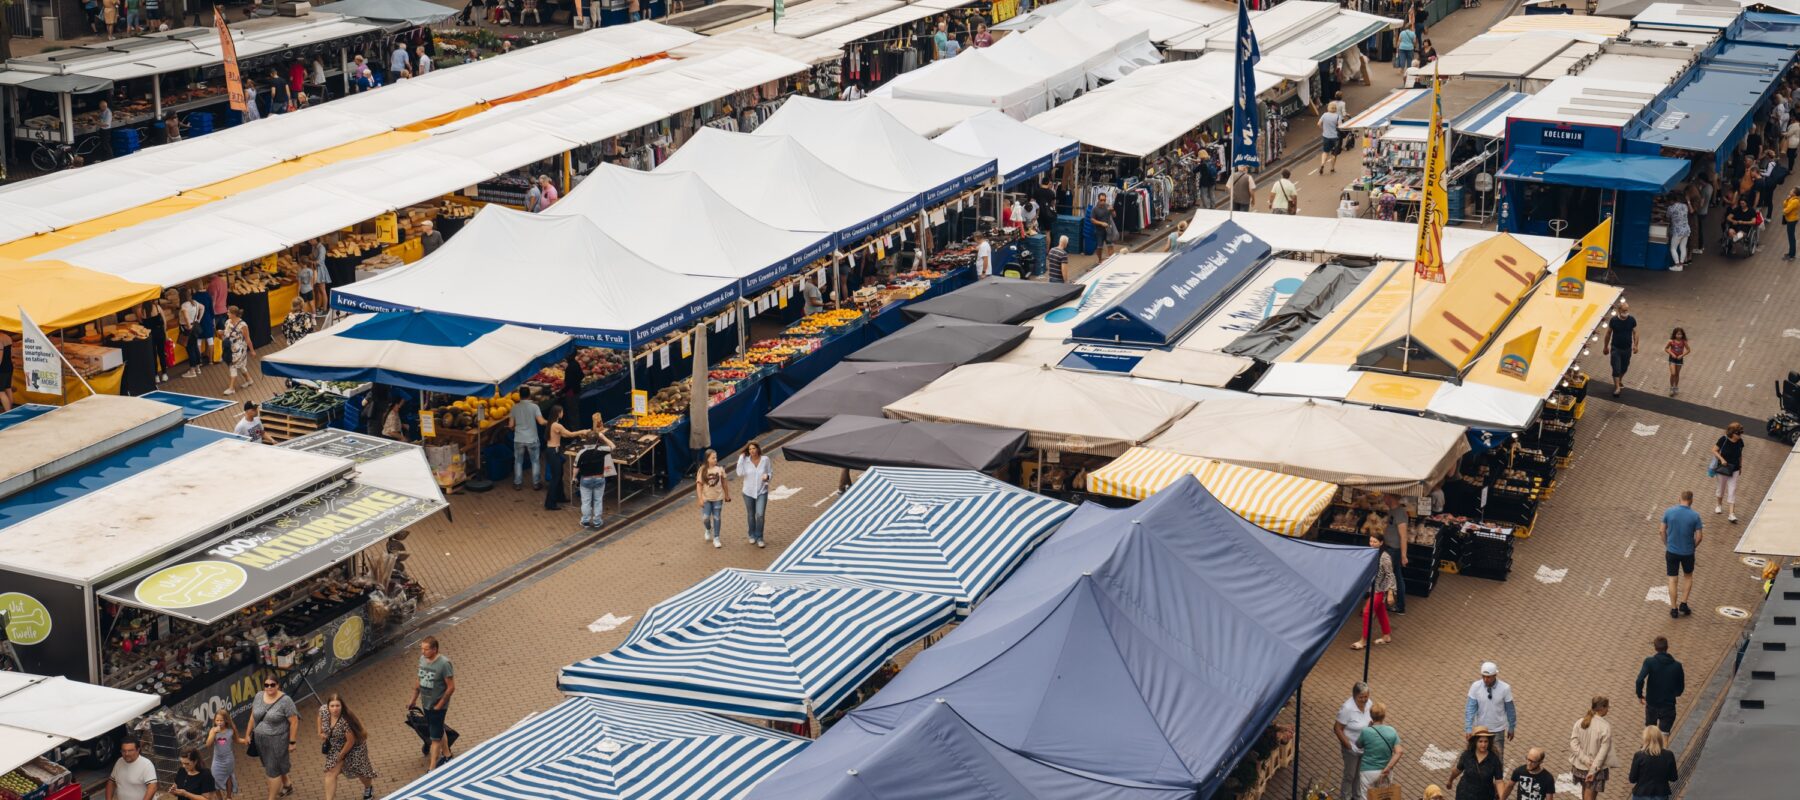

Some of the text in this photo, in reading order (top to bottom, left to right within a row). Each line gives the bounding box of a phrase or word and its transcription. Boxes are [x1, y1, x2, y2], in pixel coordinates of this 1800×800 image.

[1543, 130, 1582, 140] KOELEWIJN
[337, 294, 357, 307] kros
[358, 301, 390, 313] Groenten
[636, 330, 650, 340] kros
[650, 320, 670, 335] Groenten
[673, 313, 685, 324] Fruit
[596, 333, 604, 342] &
[604, 334, 625, 343] Fruit
[40, 370, 58, 380] BEST
[230, 489, 409, 569] NATUURLIJKE
[208, 534, 272, 558] 100%
[11, 626, 37, 640] Twelle
[192, 695, 232, 727] 100%
